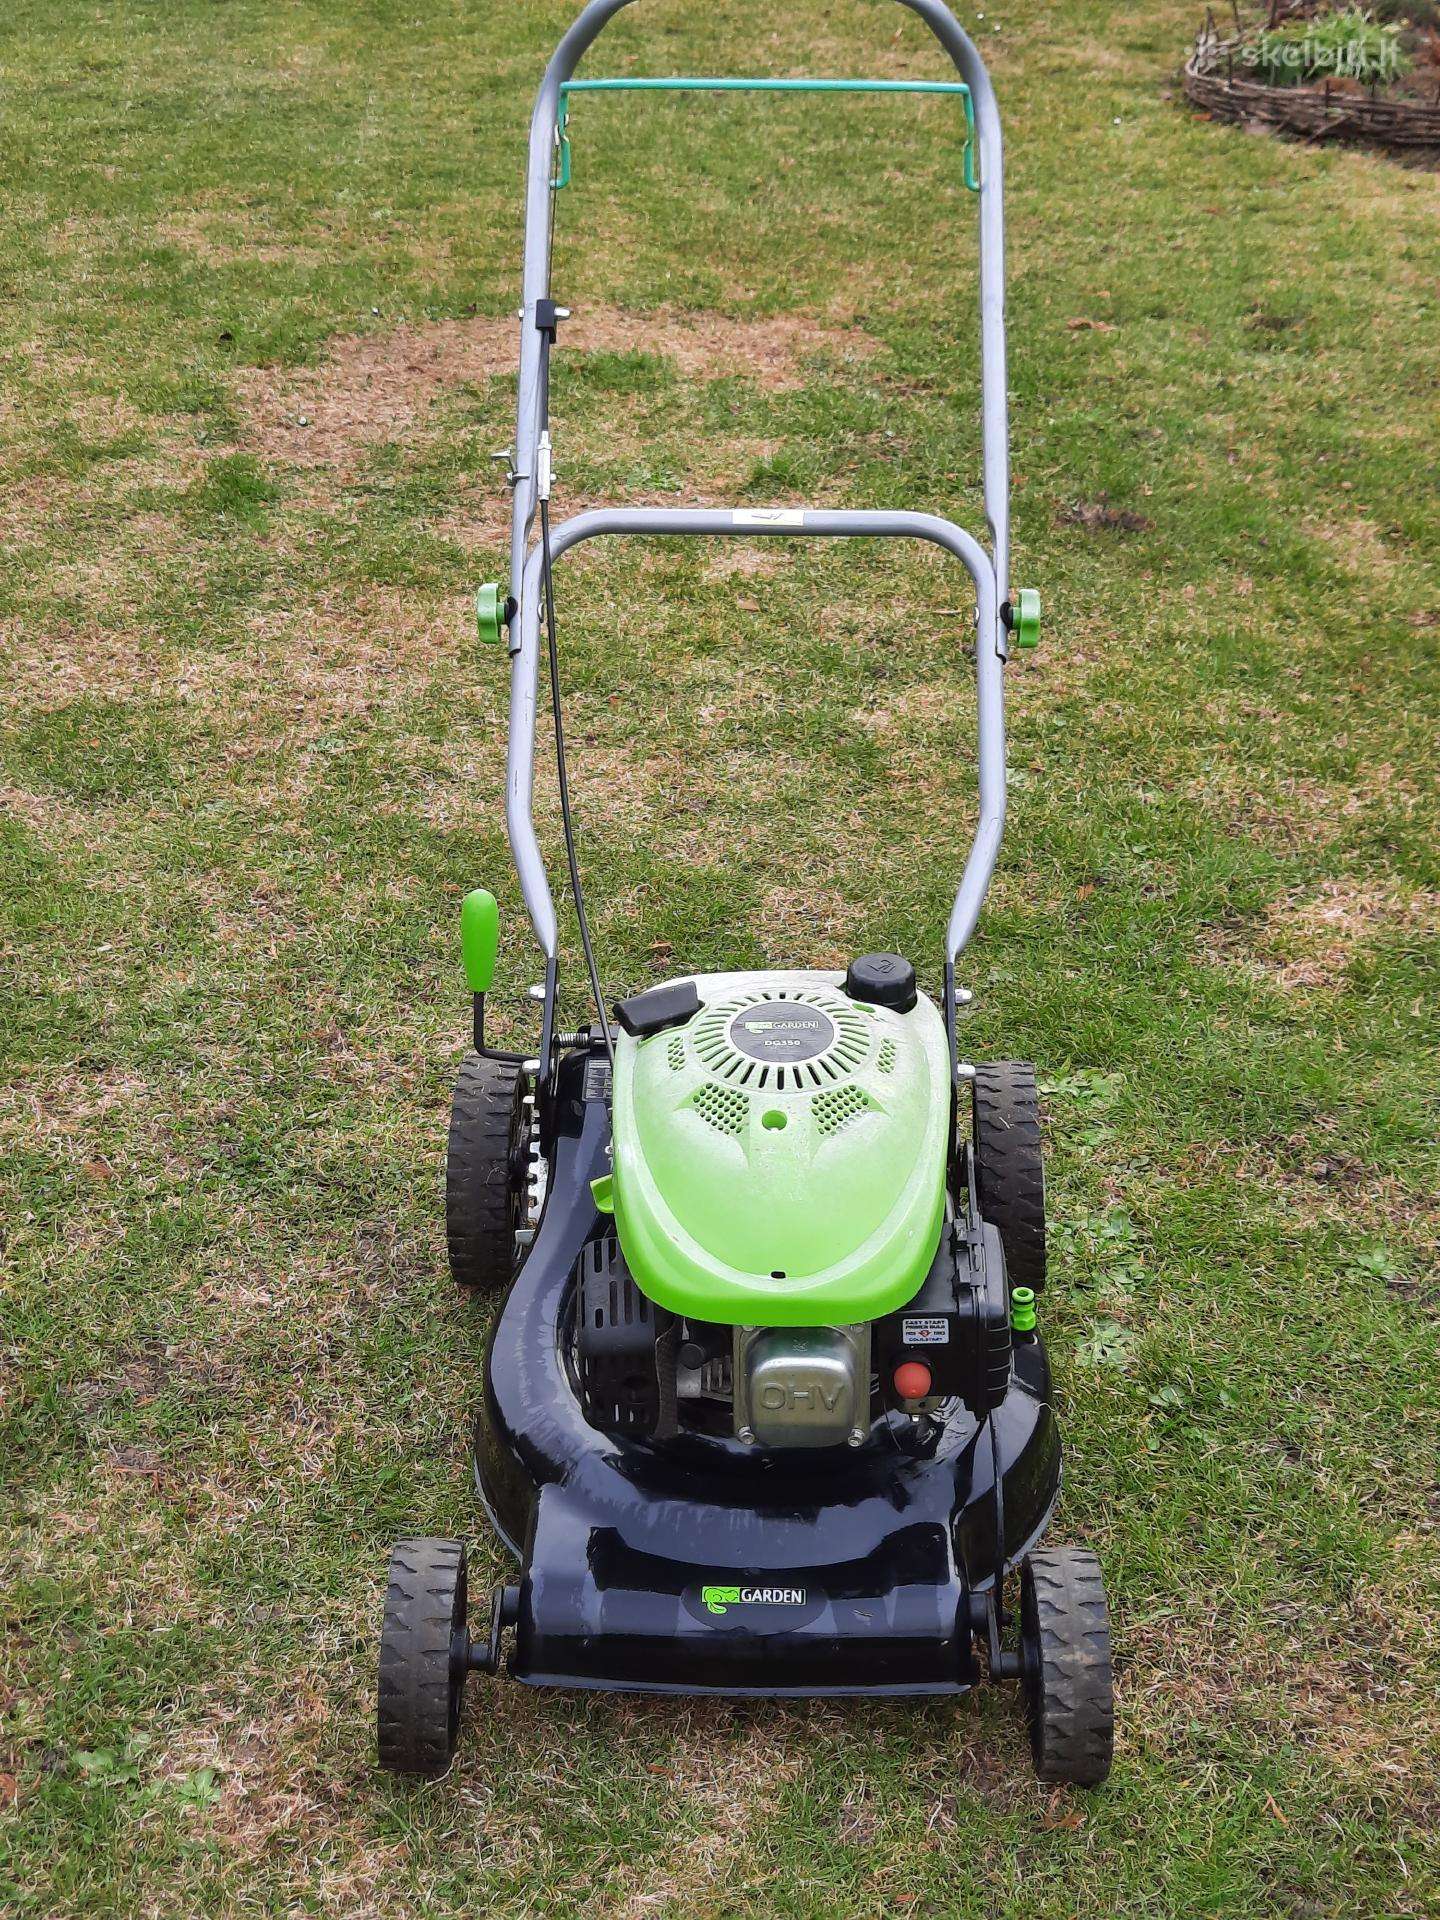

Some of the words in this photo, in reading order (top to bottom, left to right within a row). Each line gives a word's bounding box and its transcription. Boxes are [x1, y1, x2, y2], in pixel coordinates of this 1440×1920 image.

[773, 1020, 813, 1030] GARDEN
[760, 1381, 845, 1412] OHV
[741, 1588, 803, 1604] GARDEN
